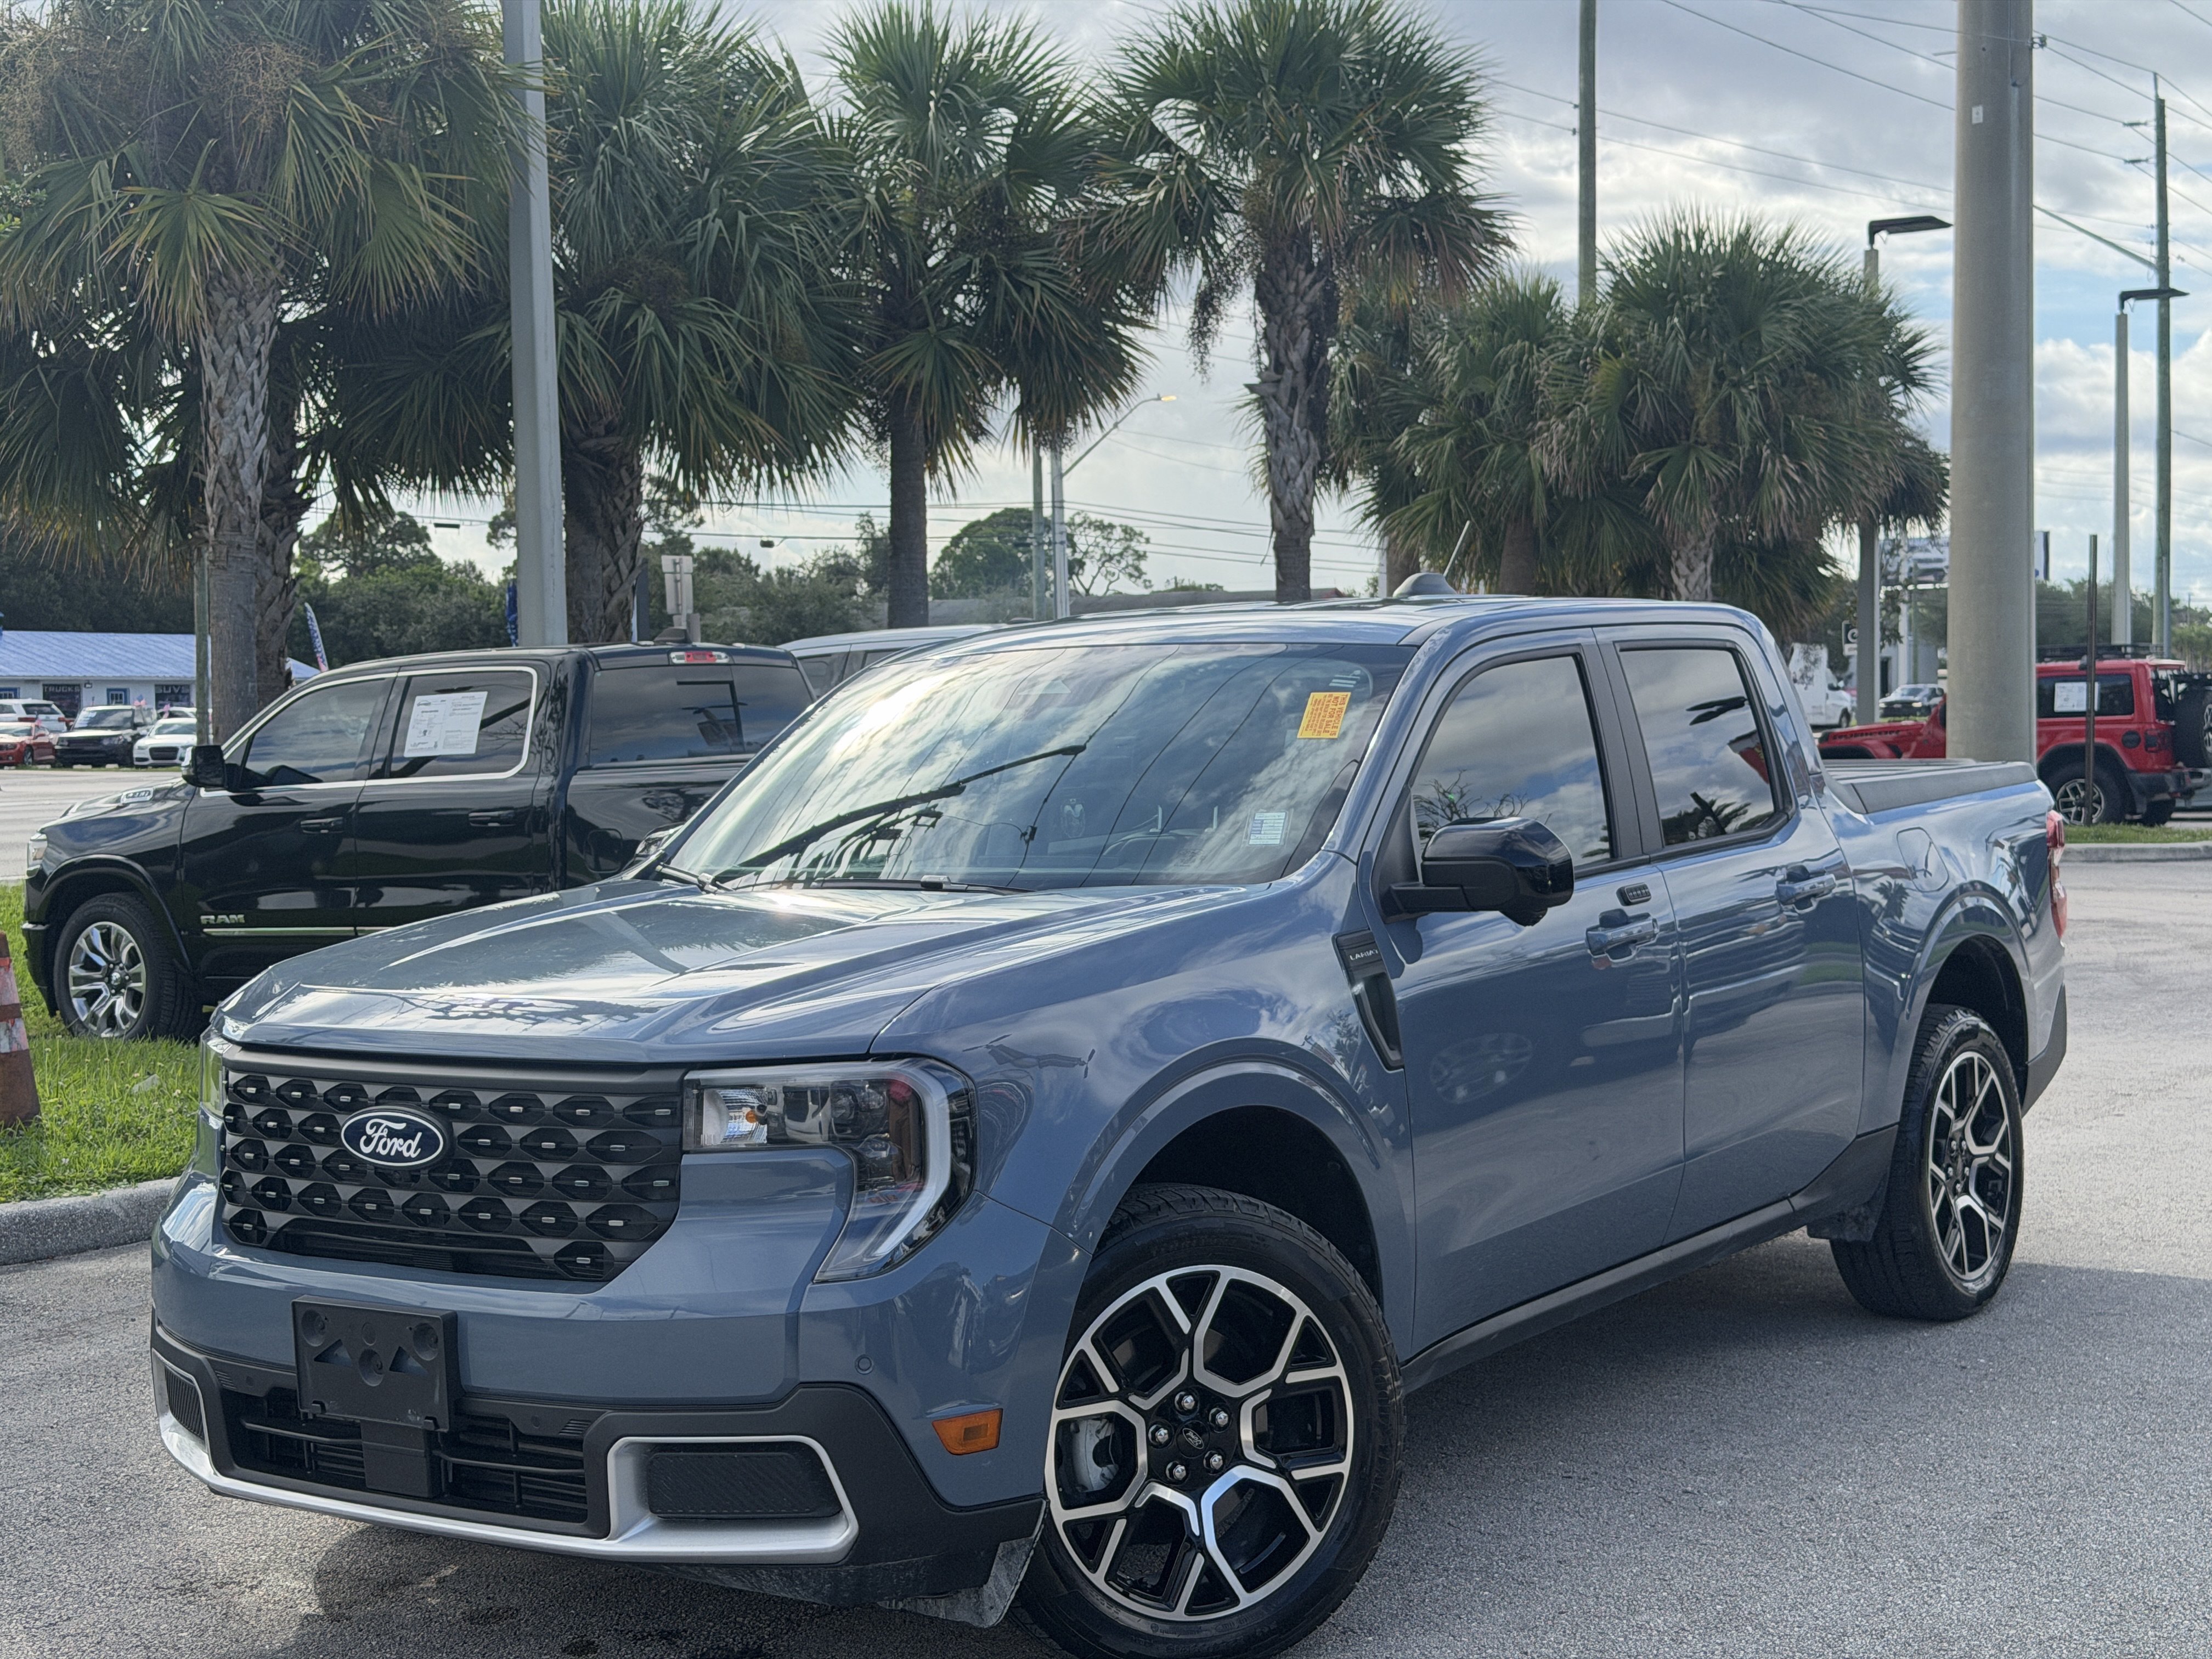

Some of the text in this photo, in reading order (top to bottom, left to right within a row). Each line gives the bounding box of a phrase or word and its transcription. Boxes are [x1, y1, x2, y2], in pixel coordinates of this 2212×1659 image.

[1339, 694, 1348, 706] THIS
[1323, 696, 1340, 733] NOT FOR SALE
[1331, 707, 1344, 729] VEHICLE
[200, 914, 245, 924] RAM
[359, 1118, 422, 1158] Ford
